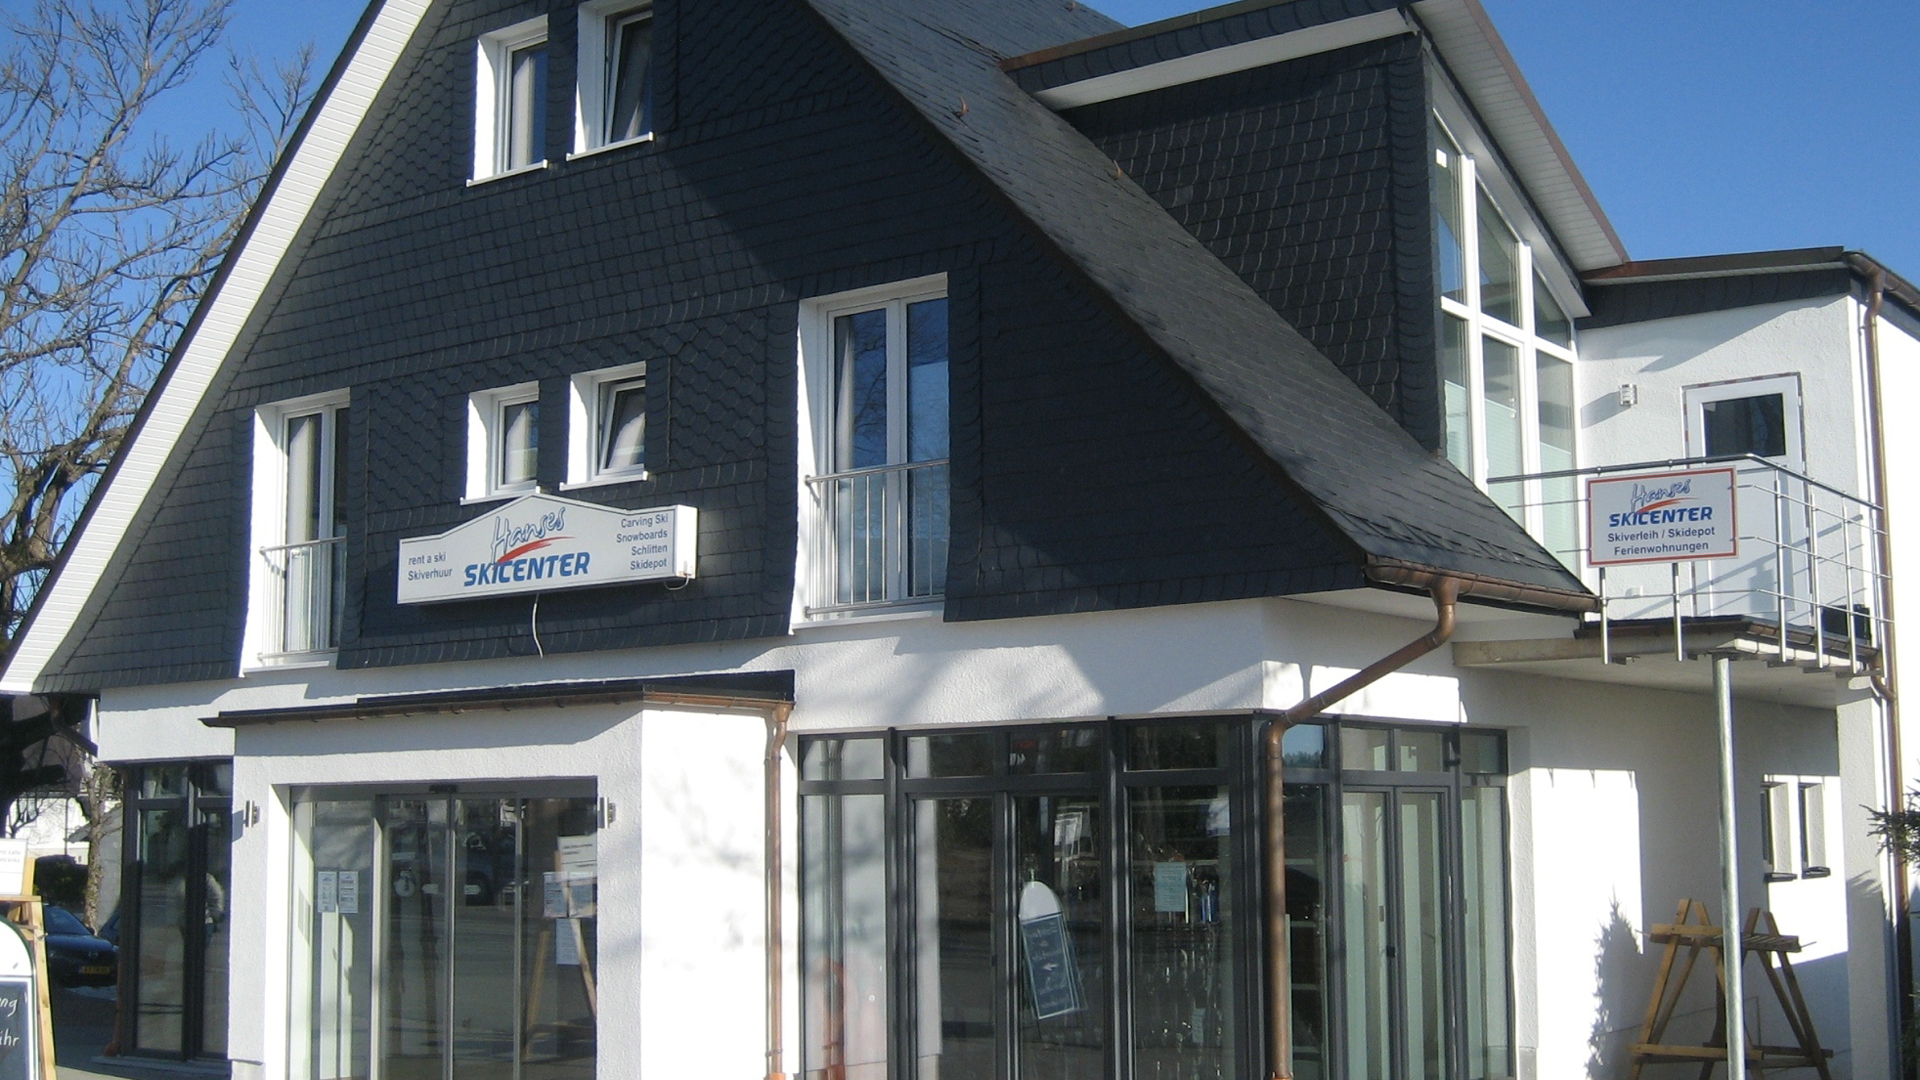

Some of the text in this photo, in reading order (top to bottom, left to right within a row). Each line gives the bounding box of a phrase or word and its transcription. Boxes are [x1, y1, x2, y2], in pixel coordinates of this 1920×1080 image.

[1630, 479, 1692, 513] Hanses
[620, 513, 669, 529] Carving Ski
[1609, 506, 1713, 528] SKICENTER
[490, 507, 566, 565] Hanses
[616, 528, 668, 543] Snowboards
[1607, 531, 1659, 543] Skiverleih
[1668, 526, 1716, 540] Skidepot
[631, 544, 668, 556] Schlitten
[1614, 541, 1709, 556] Ferienwohnungen
[408, 551, 446, 566] rent a ski
[630, 558, 668, 571] Skidepot
[408, 567, 453, 581] Skiverhuur
[463, 551, 591, 587] SKICENTER
[0, 997, 18, 1018] ng
